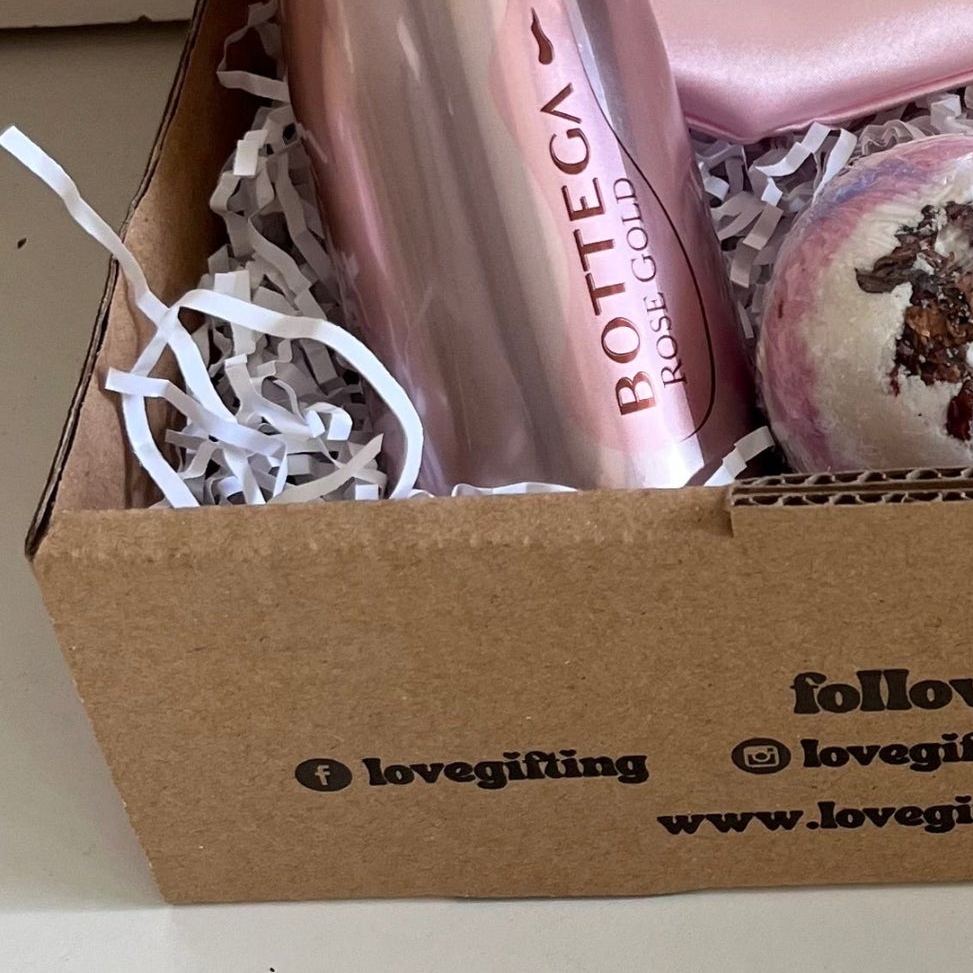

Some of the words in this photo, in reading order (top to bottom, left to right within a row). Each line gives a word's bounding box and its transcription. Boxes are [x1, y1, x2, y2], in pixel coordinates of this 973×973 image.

[540, 83, 657, 416] BOTTEGA
[614, 177, 657, 283] GOLD
[645, 291, 687, 388] ROSE
[365, 750, 649, 789] lovegifting
